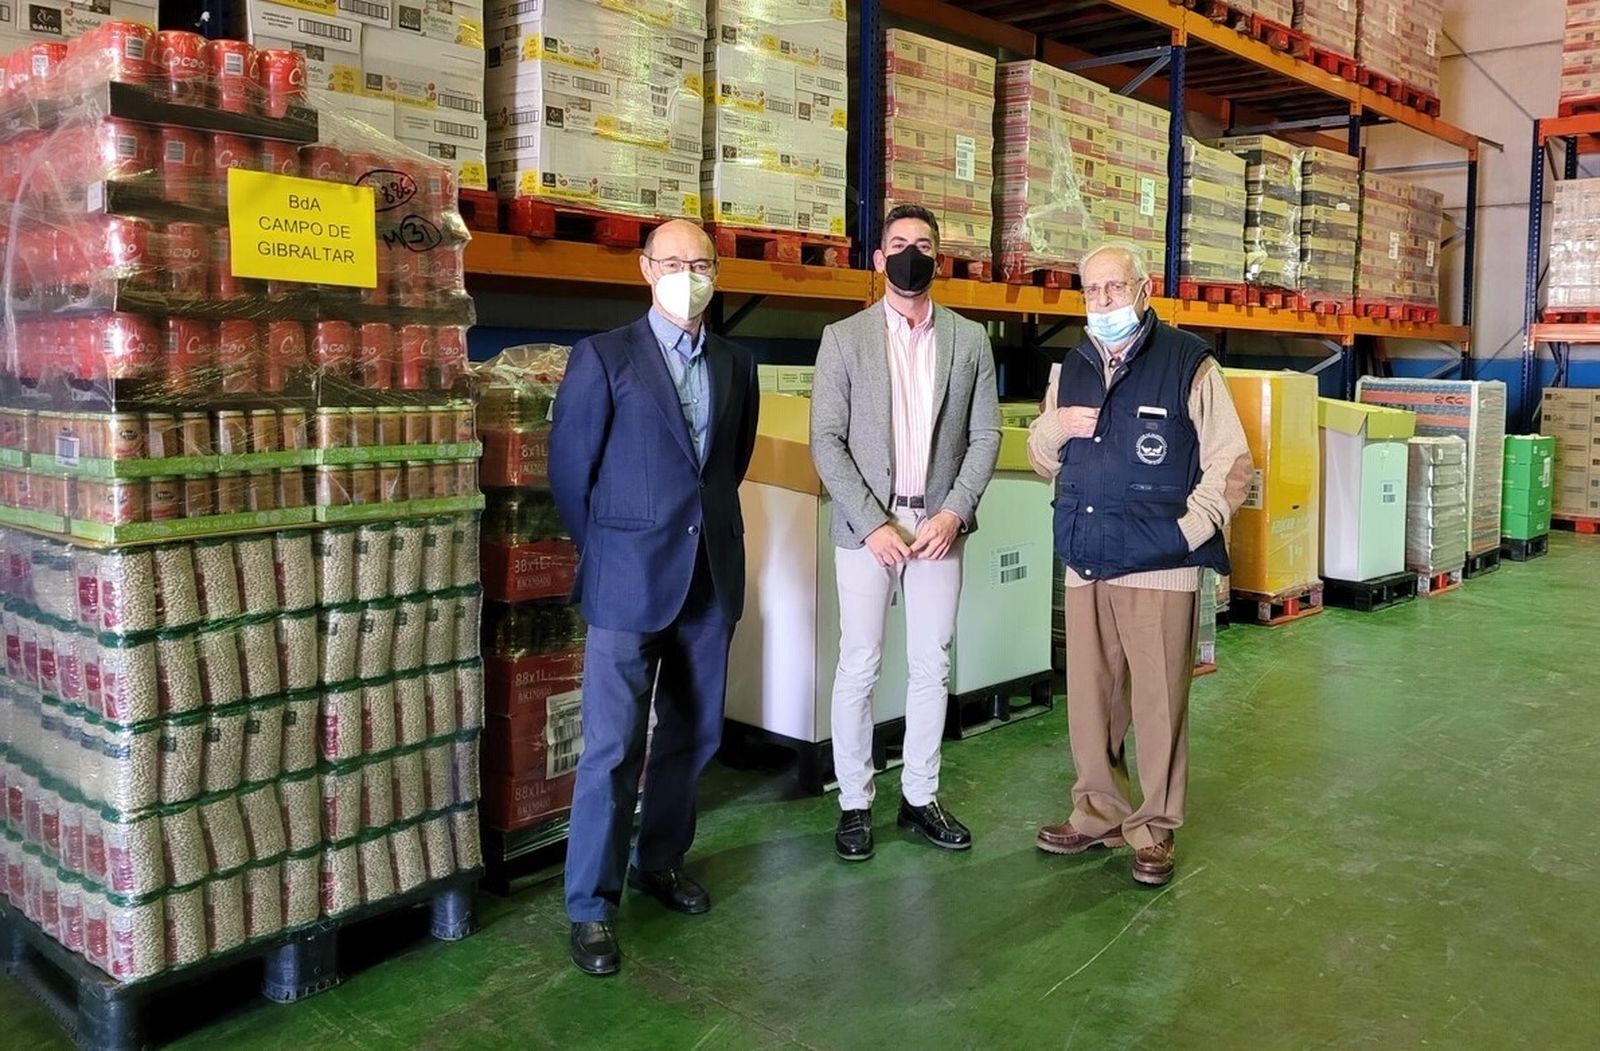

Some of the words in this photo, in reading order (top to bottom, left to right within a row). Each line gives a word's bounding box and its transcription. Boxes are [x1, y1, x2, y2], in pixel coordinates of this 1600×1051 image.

[31, 23, 60, 33] GALLO
[161, 46, 206, 69] Cacao
[288, 194, 322, 212] BdA
[258, 216, 324, 236] CAMPO
[328, 224, 352, 239] DE
[257, 240, 355, 264] GIBRALTAR
